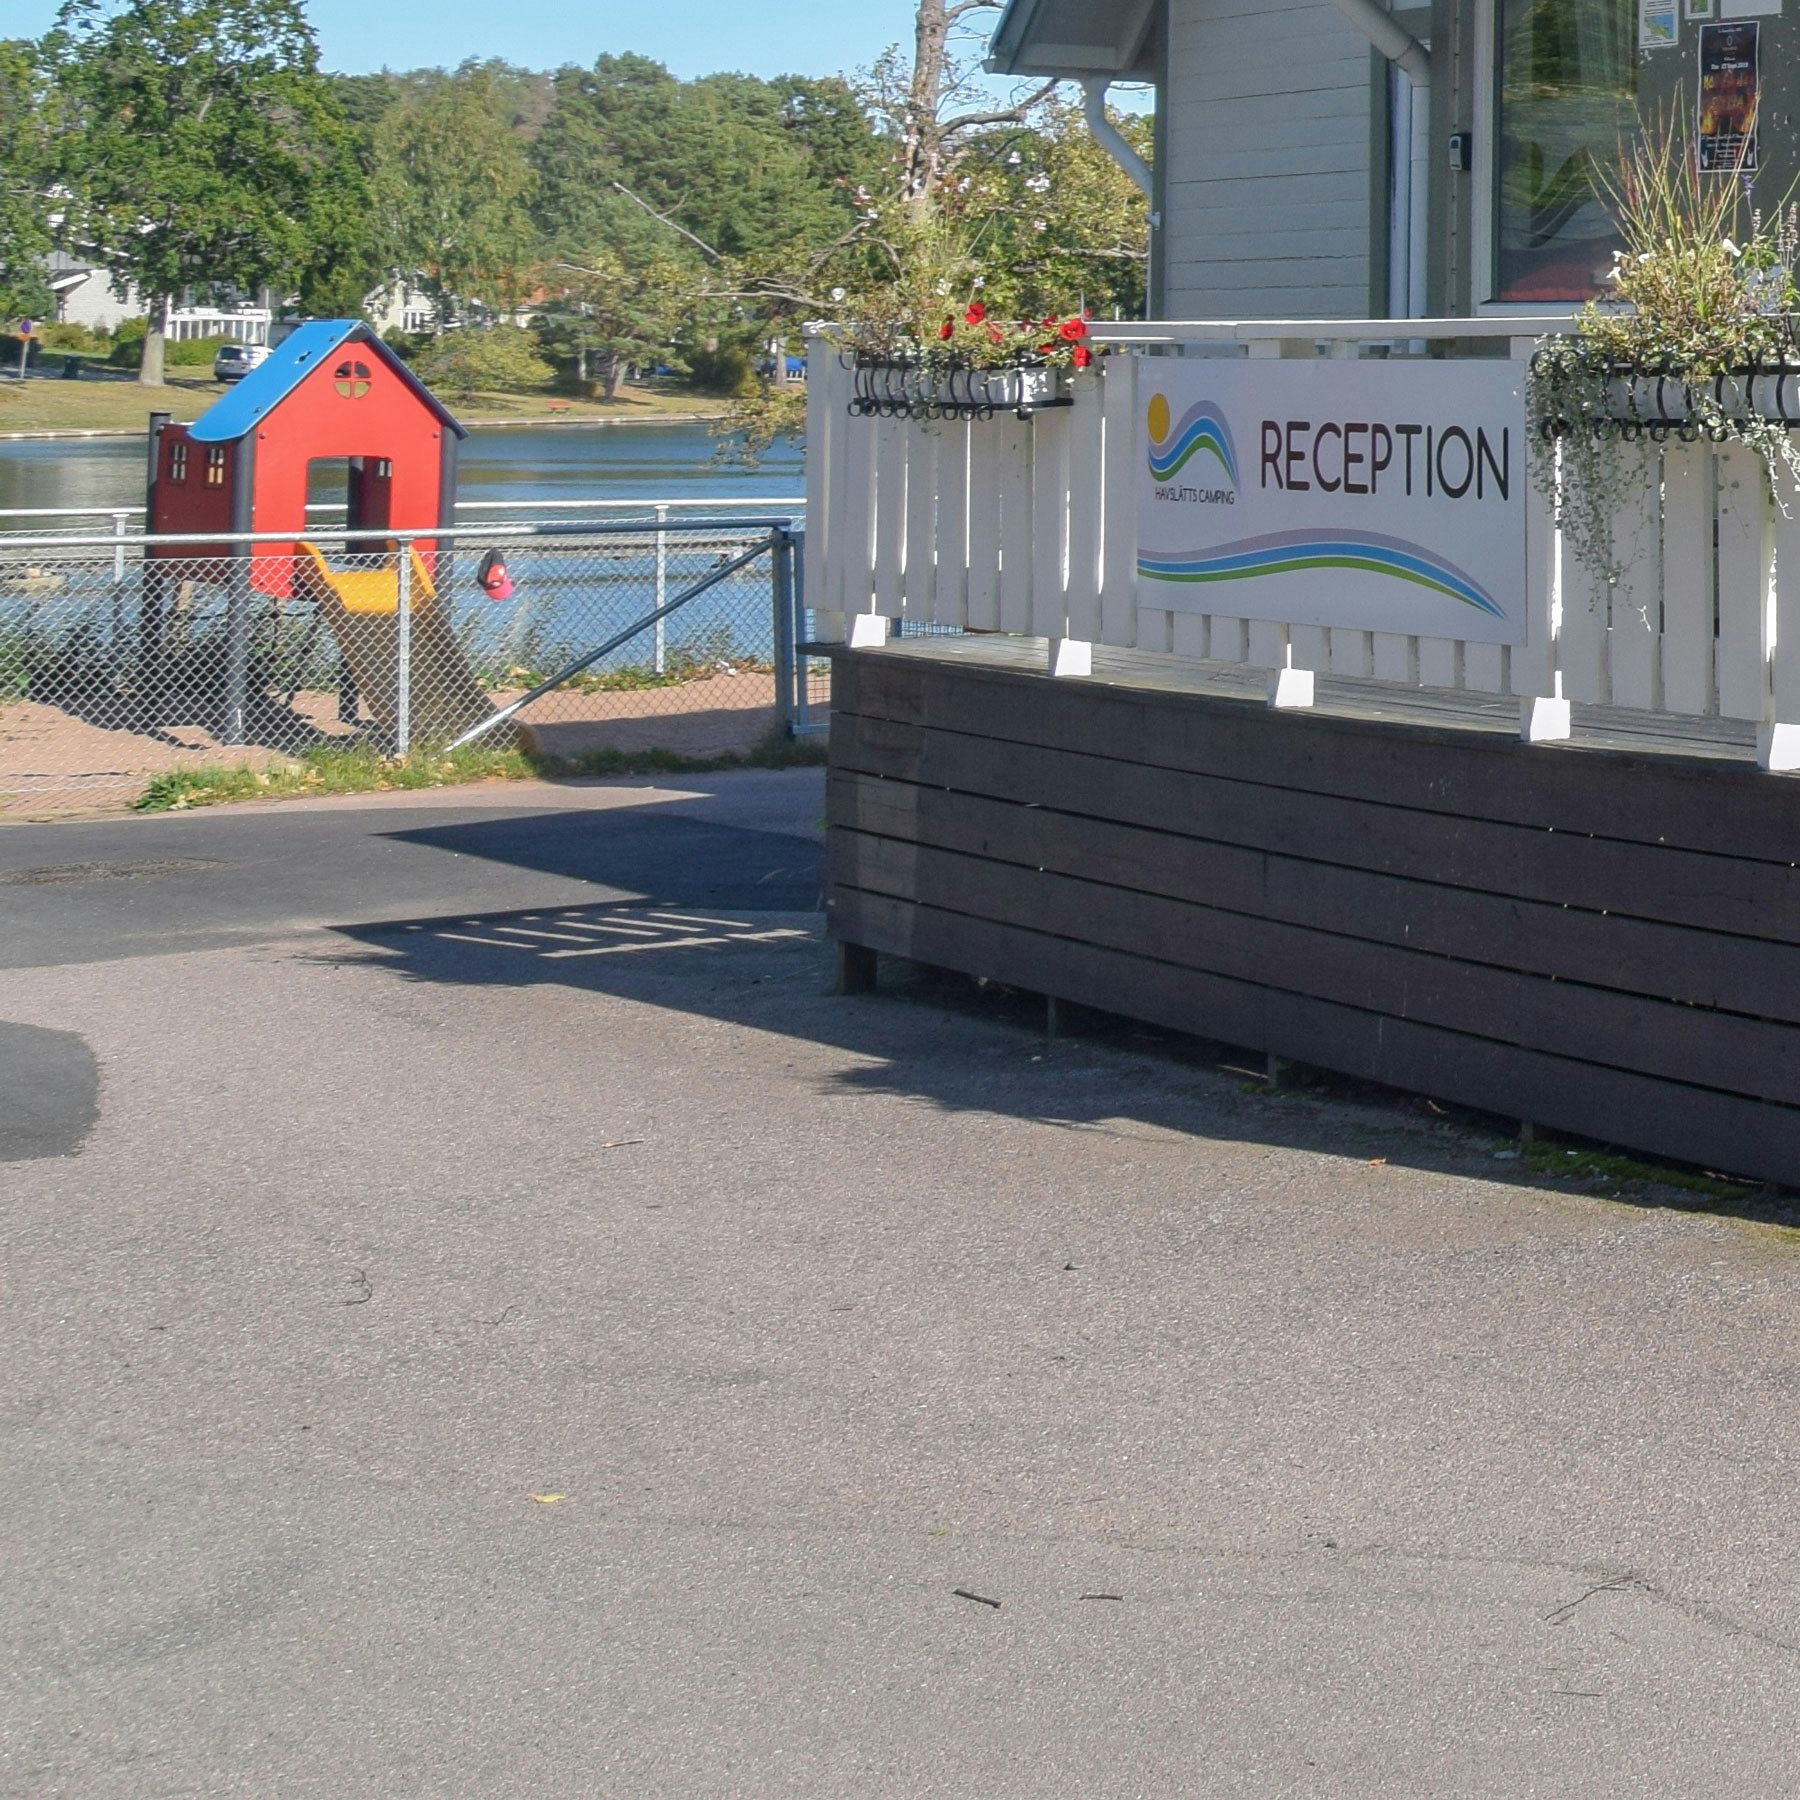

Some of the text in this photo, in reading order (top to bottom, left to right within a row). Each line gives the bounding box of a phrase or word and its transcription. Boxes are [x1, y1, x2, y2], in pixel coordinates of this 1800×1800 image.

[1261, 420, 1509, 501] RECEPTION
[1155, 485, 1235, 505] HAVSLÄTTS CAMPING
